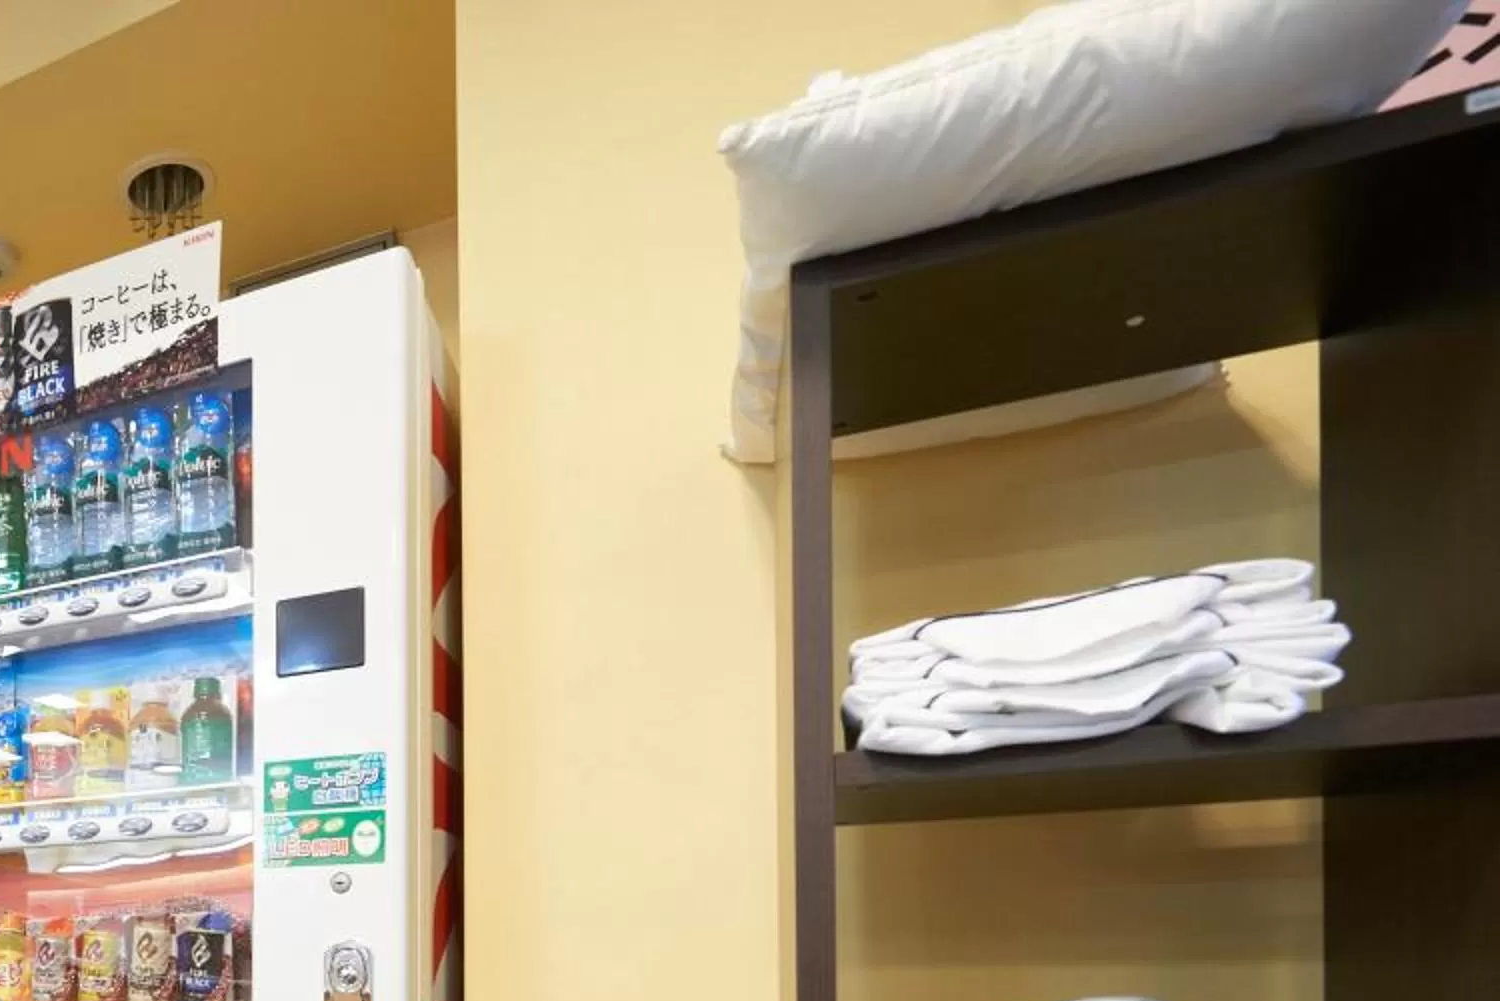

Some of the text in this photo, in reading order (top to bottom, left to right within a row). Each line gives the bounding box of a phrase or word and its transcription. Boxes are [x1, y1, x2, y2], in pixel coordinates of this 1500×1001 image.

[81, 268, 178, 315] コーヒーは、
[79, 294, 212, 355] 「焼き」で極まる。
[25, 360, 60, 383] FIRE
[17, 376, 66, 407] BLACK
